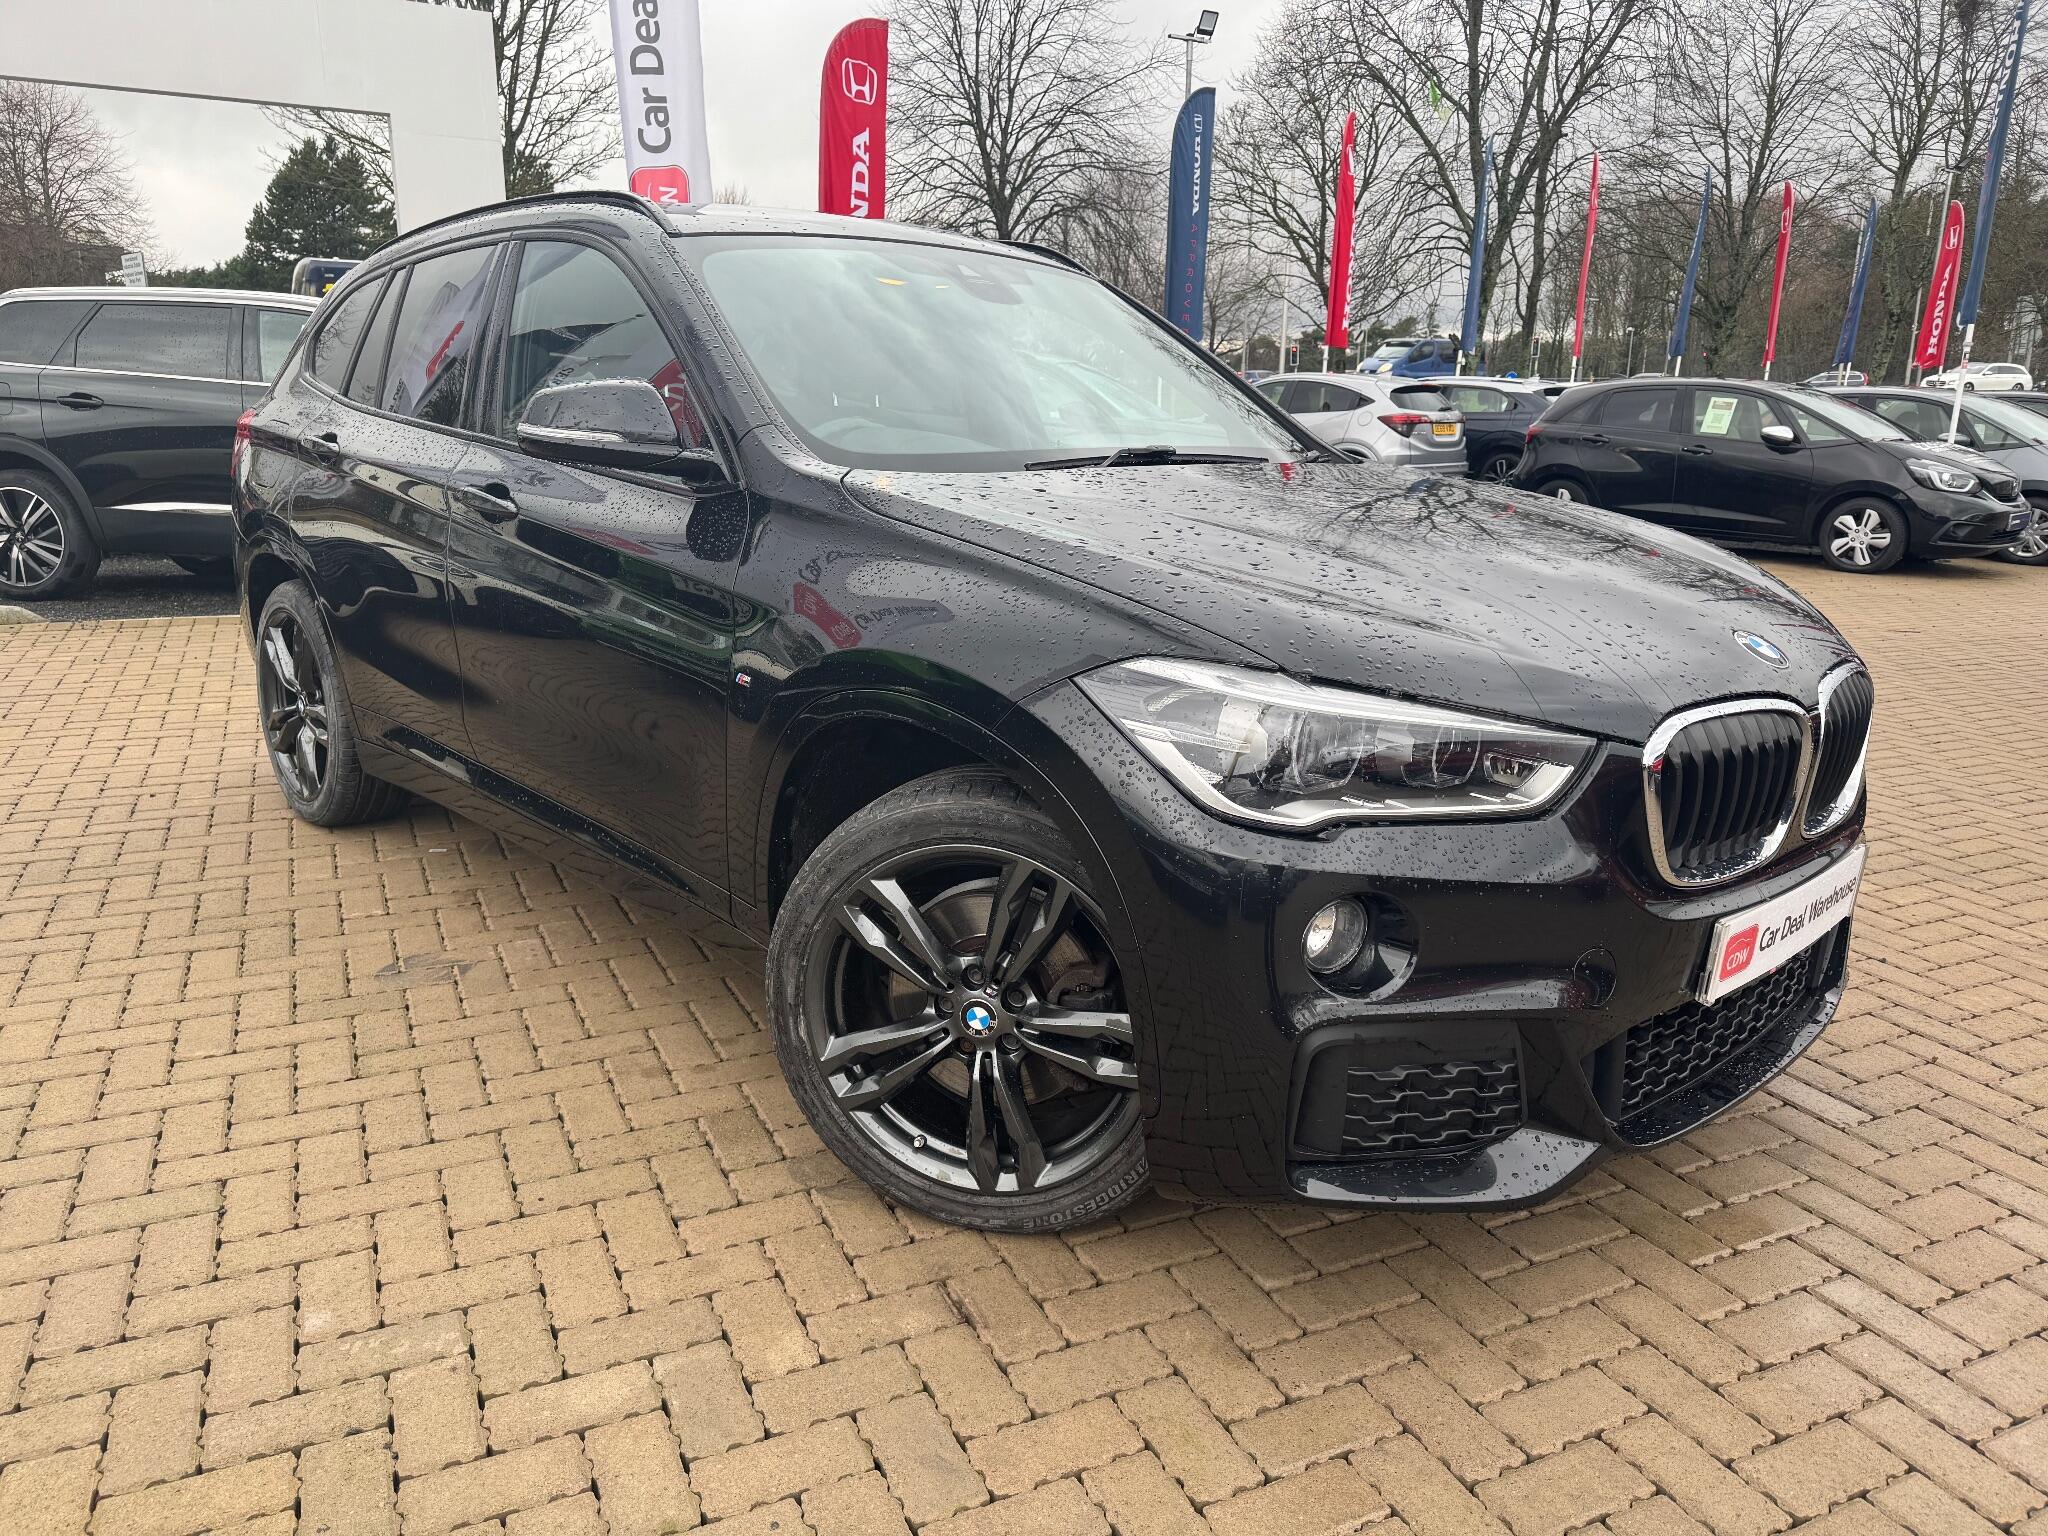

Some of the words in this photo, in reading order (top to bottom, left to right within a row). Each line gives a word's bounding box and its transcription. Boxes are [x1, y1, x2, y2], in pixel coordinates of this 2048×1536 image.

[637, 87, 672, 154] Car
[1191, 134, 1201, 217] HONDA
[1925, 262, 1953, 356] HONDA
[1759, 926, 1781, 952] Car
[1780, 904, 1808, 941] Deal
[1808, 876, 1857, 924] Warehouse
[1726, 946, 1750, 971] CDW
